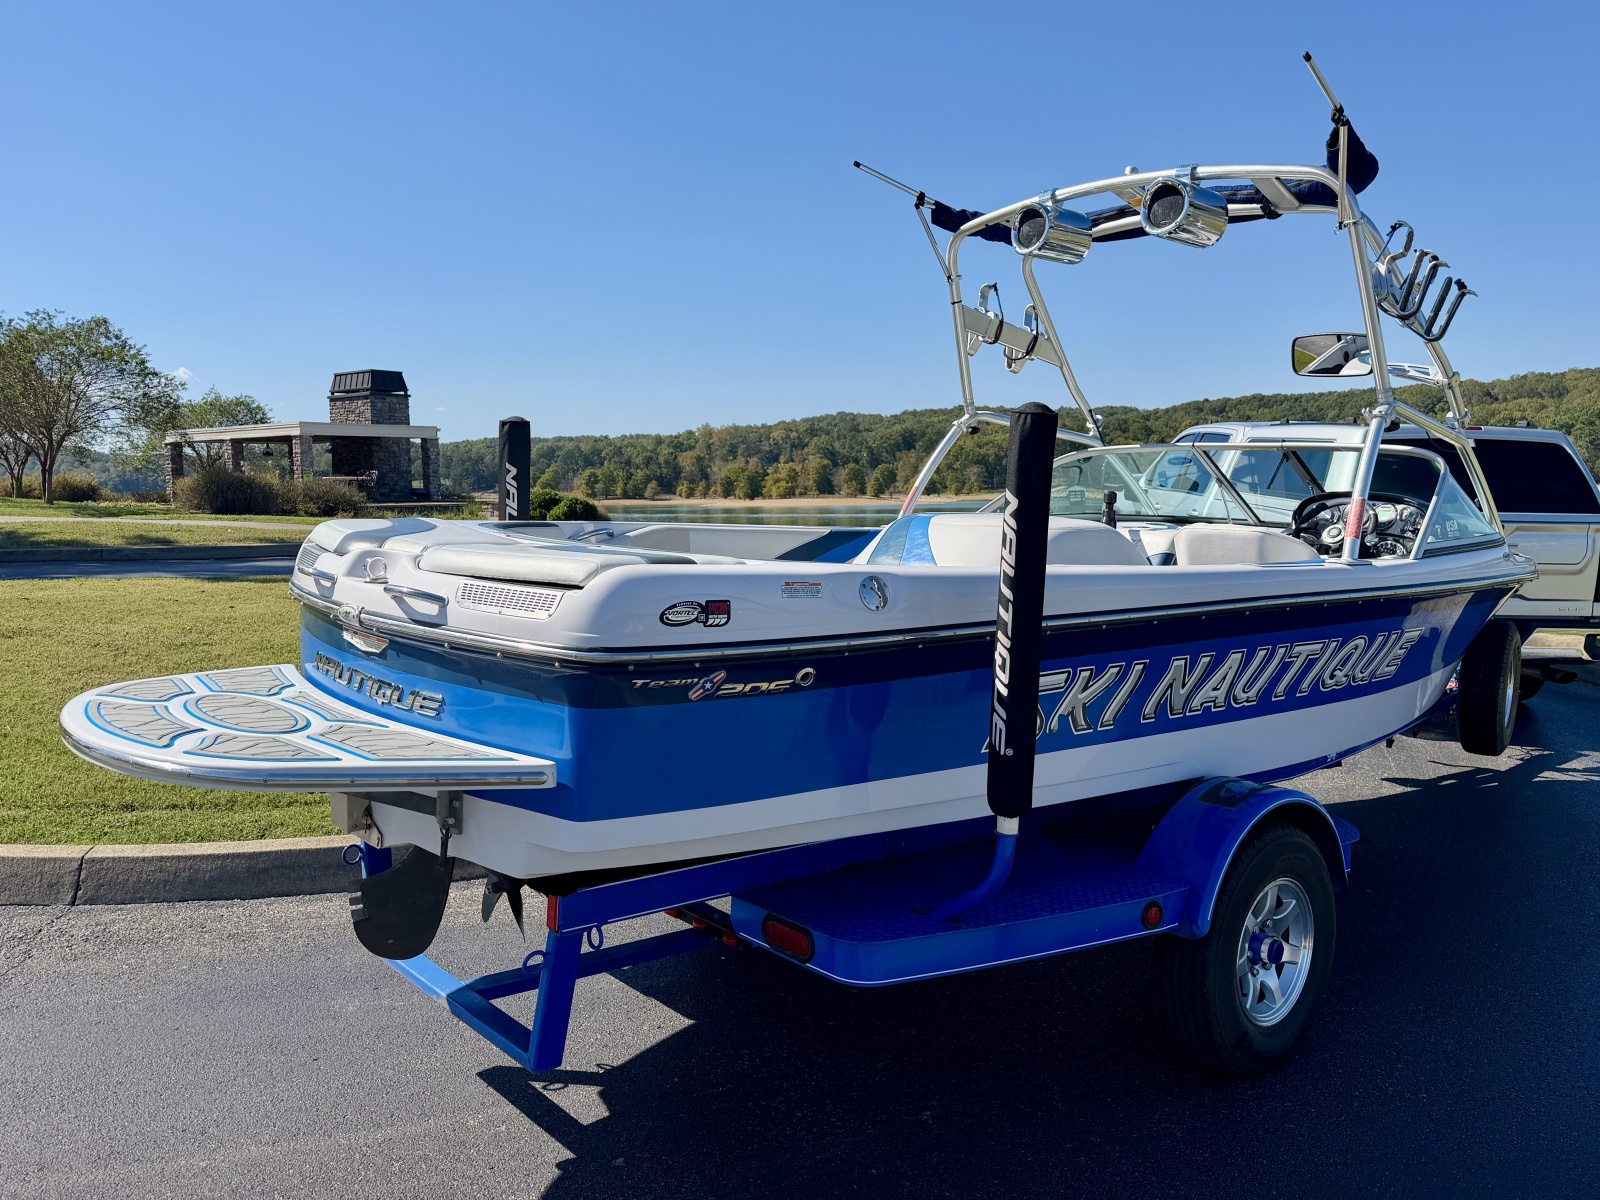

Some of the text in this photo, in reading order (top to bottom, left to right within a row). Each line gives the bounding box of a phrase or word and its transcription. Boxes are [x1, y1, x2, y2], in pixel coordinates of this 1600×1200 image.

[314, 650, 446, 718] NAUTIQUE
[631, 678, 699, 690] Team
[1141, 627, 1425, 724] NAUTIQUE
